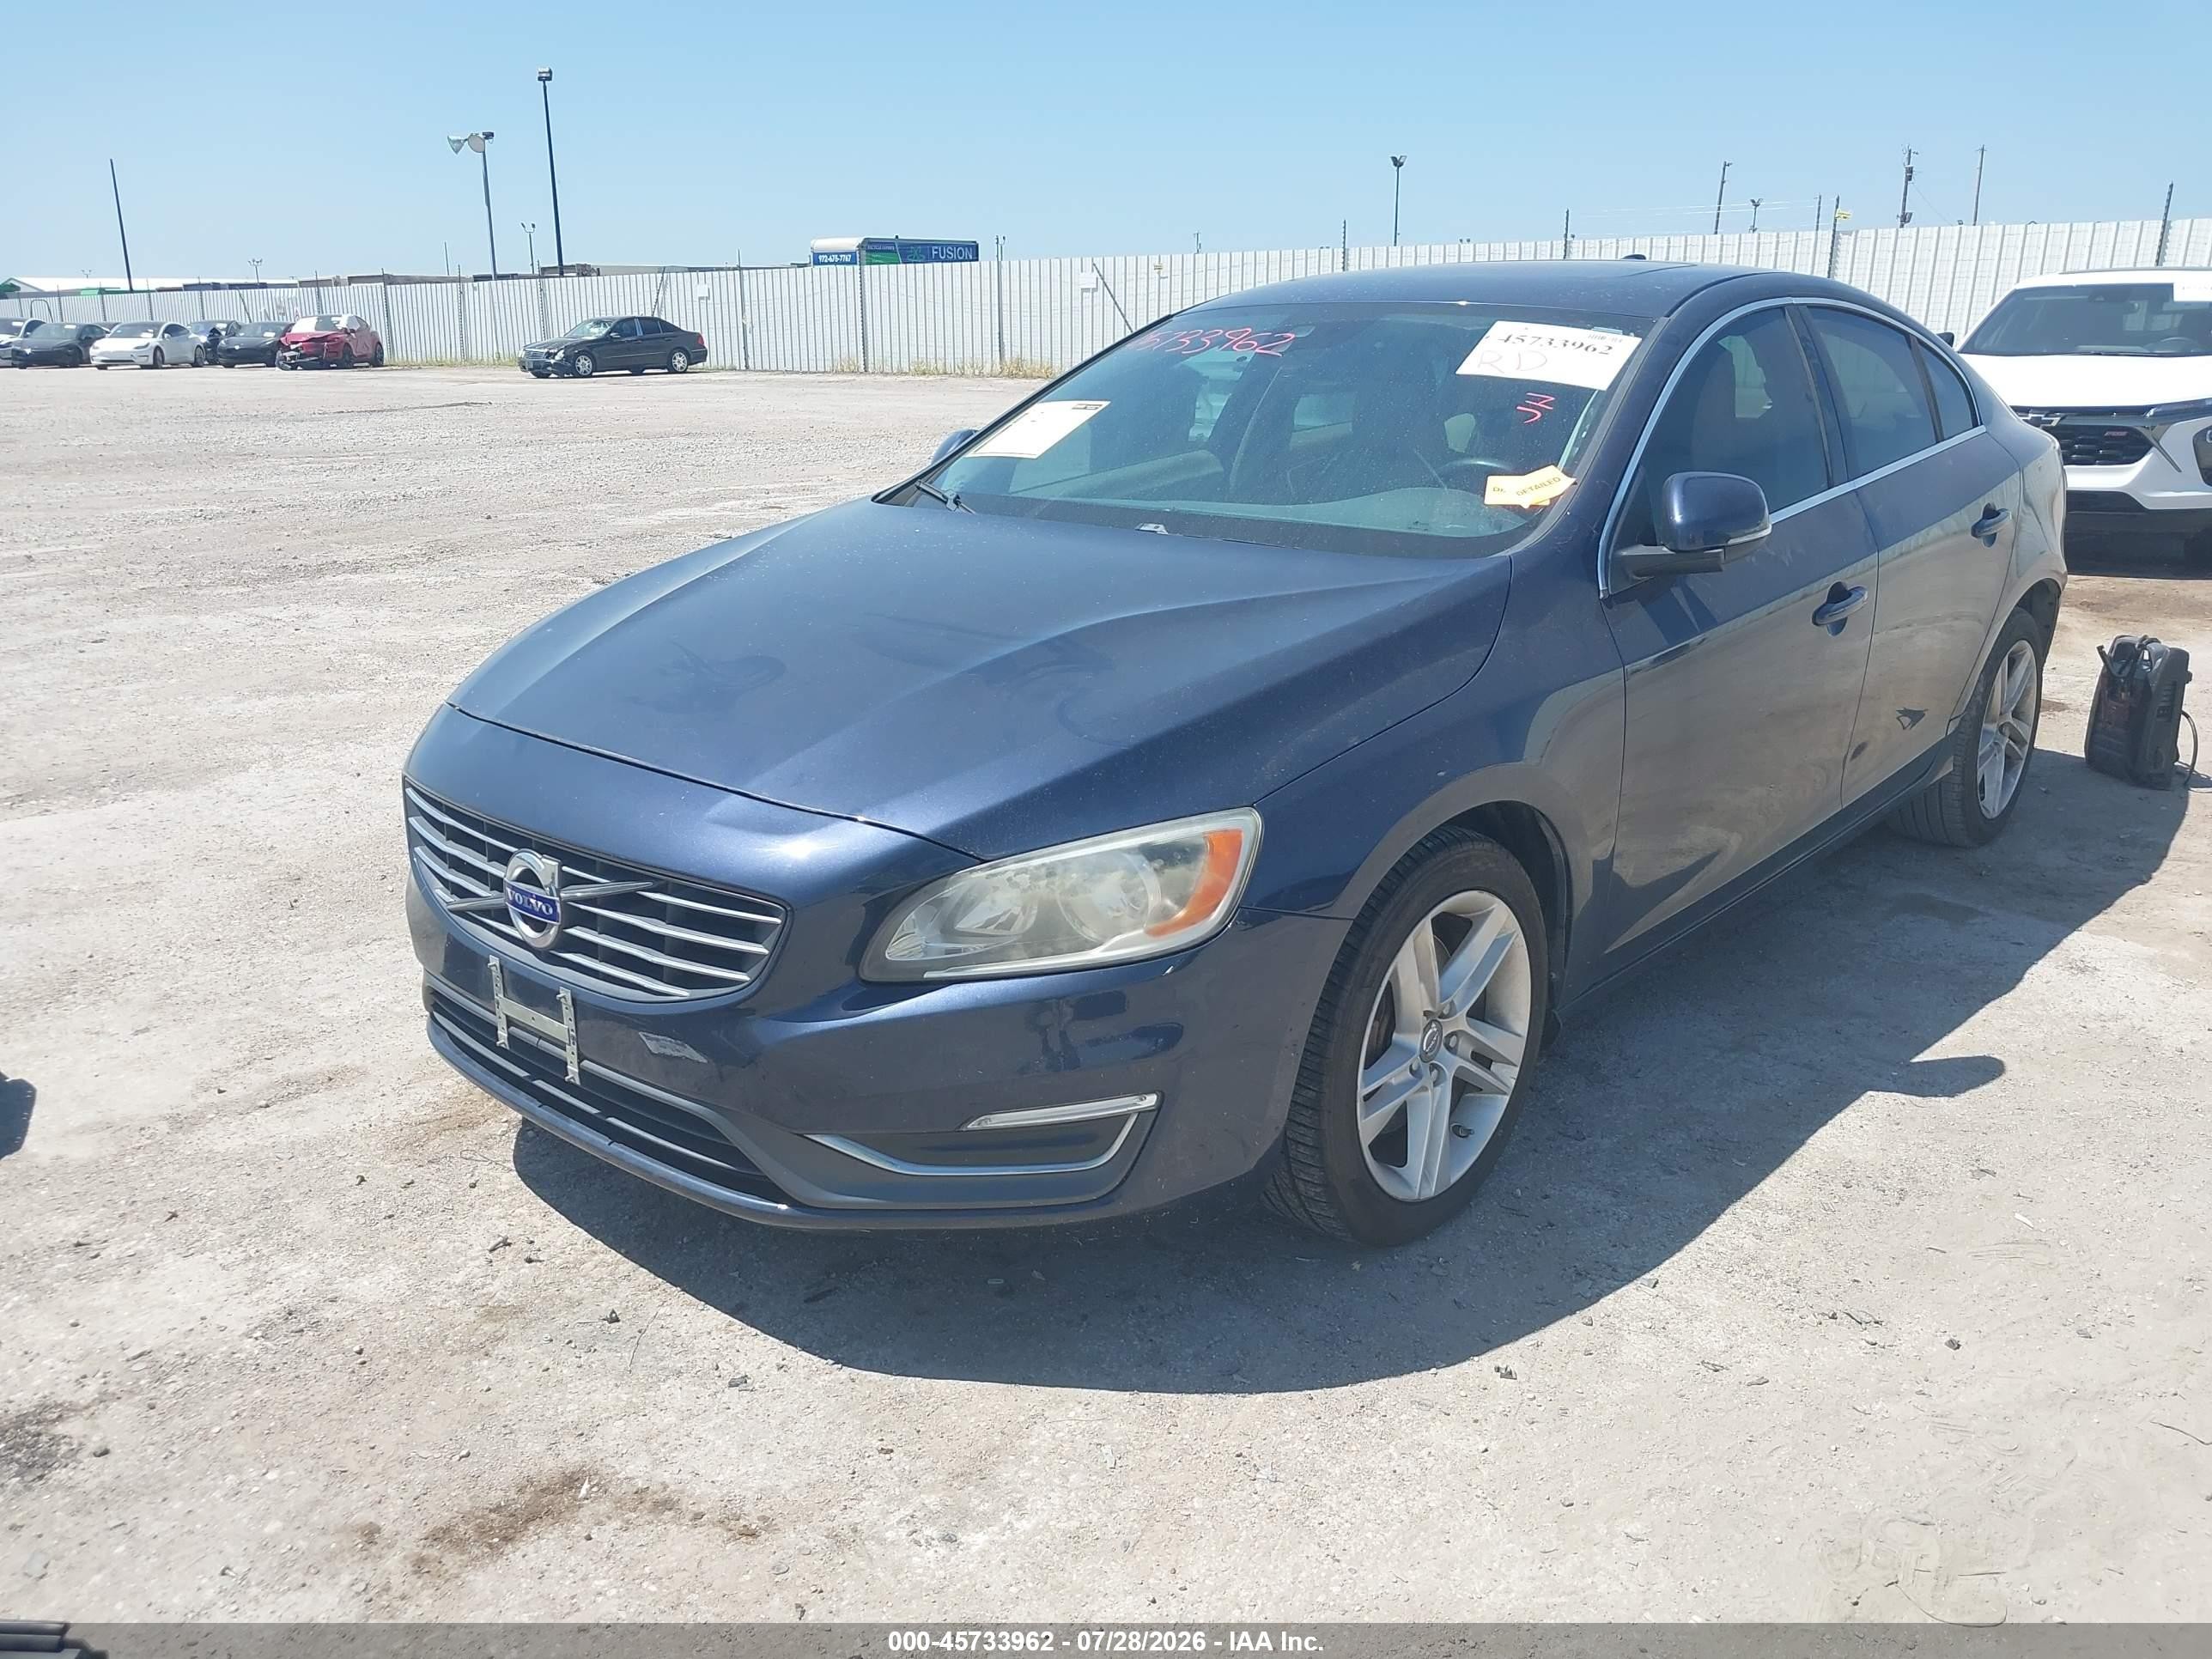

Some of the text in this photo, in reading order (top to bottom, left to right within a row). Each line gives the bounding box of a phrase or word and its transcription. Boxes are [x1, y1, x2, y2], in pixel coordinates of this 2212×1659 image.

[932, 246, 973, 260] FUSION
[1498, 333, 1613, 356] 45733962
[1516, 477, 1561, 496] DETAILED
[506, 887, 554, 915] VOLVO
